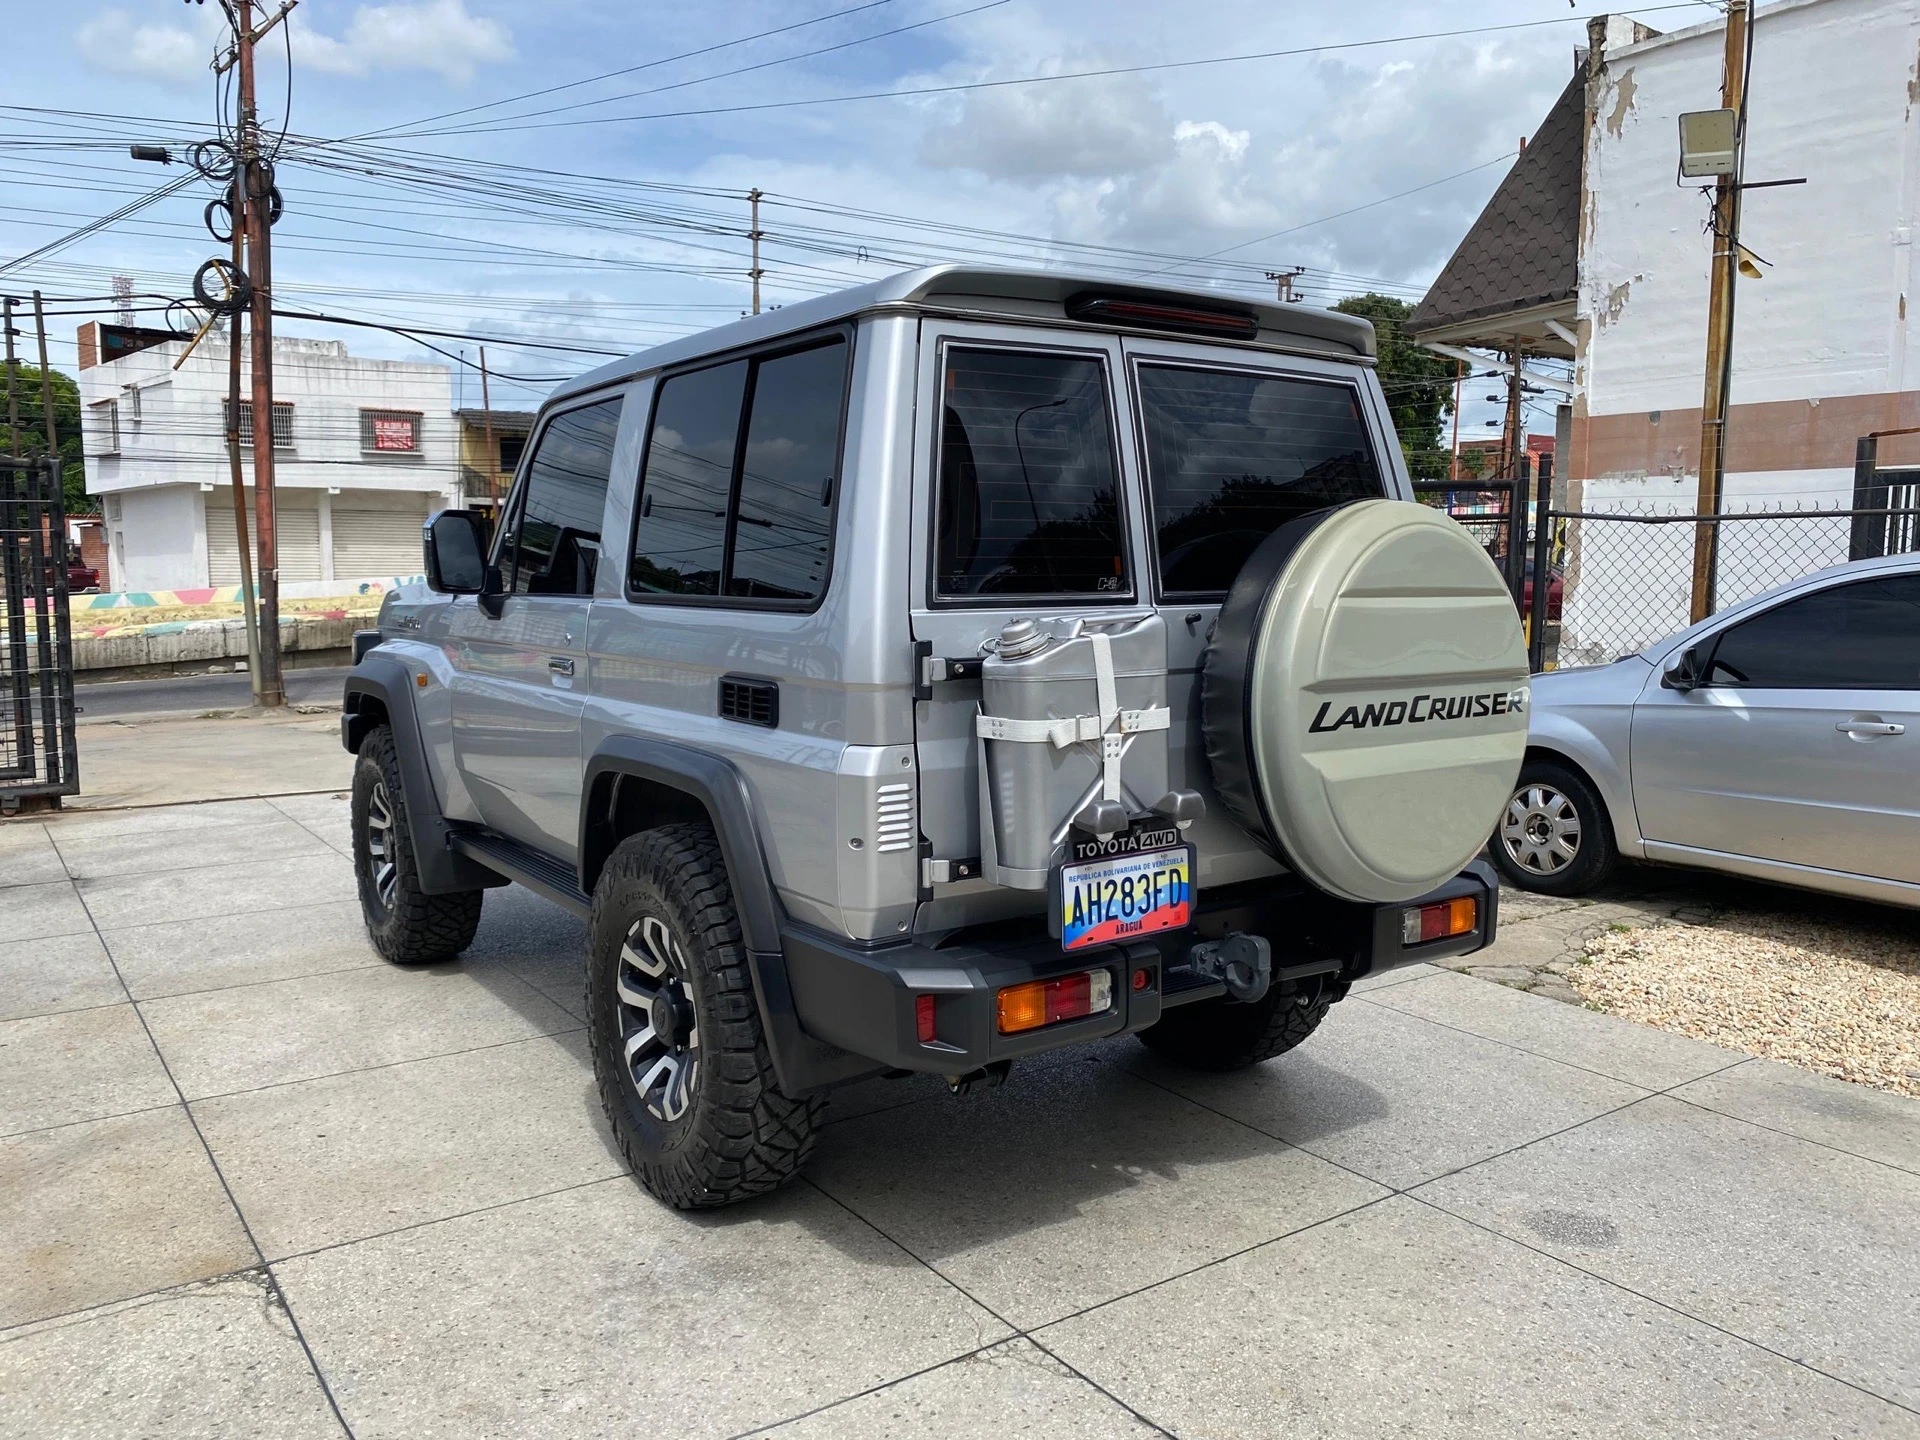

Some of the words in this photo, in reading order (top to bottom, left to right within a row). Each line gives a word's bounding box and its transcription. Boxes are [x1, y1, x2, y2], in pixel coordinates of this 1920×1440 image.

[1077, 837, 1137, 858] TOYOTA
[1140, 830, 1176, 849] 4WD
[1068, 870, 1102, 883] REPUBLICA
[1103, 863, 1141, 878] BOLIVARIANA
[1143, 862, 1151, 870] DE
[1152, 856, 1184, 869] VENEZUELA
[1072, 868, 1181, 927] AH283FD
[1115, 919, 1143, 935] ARAGUA
